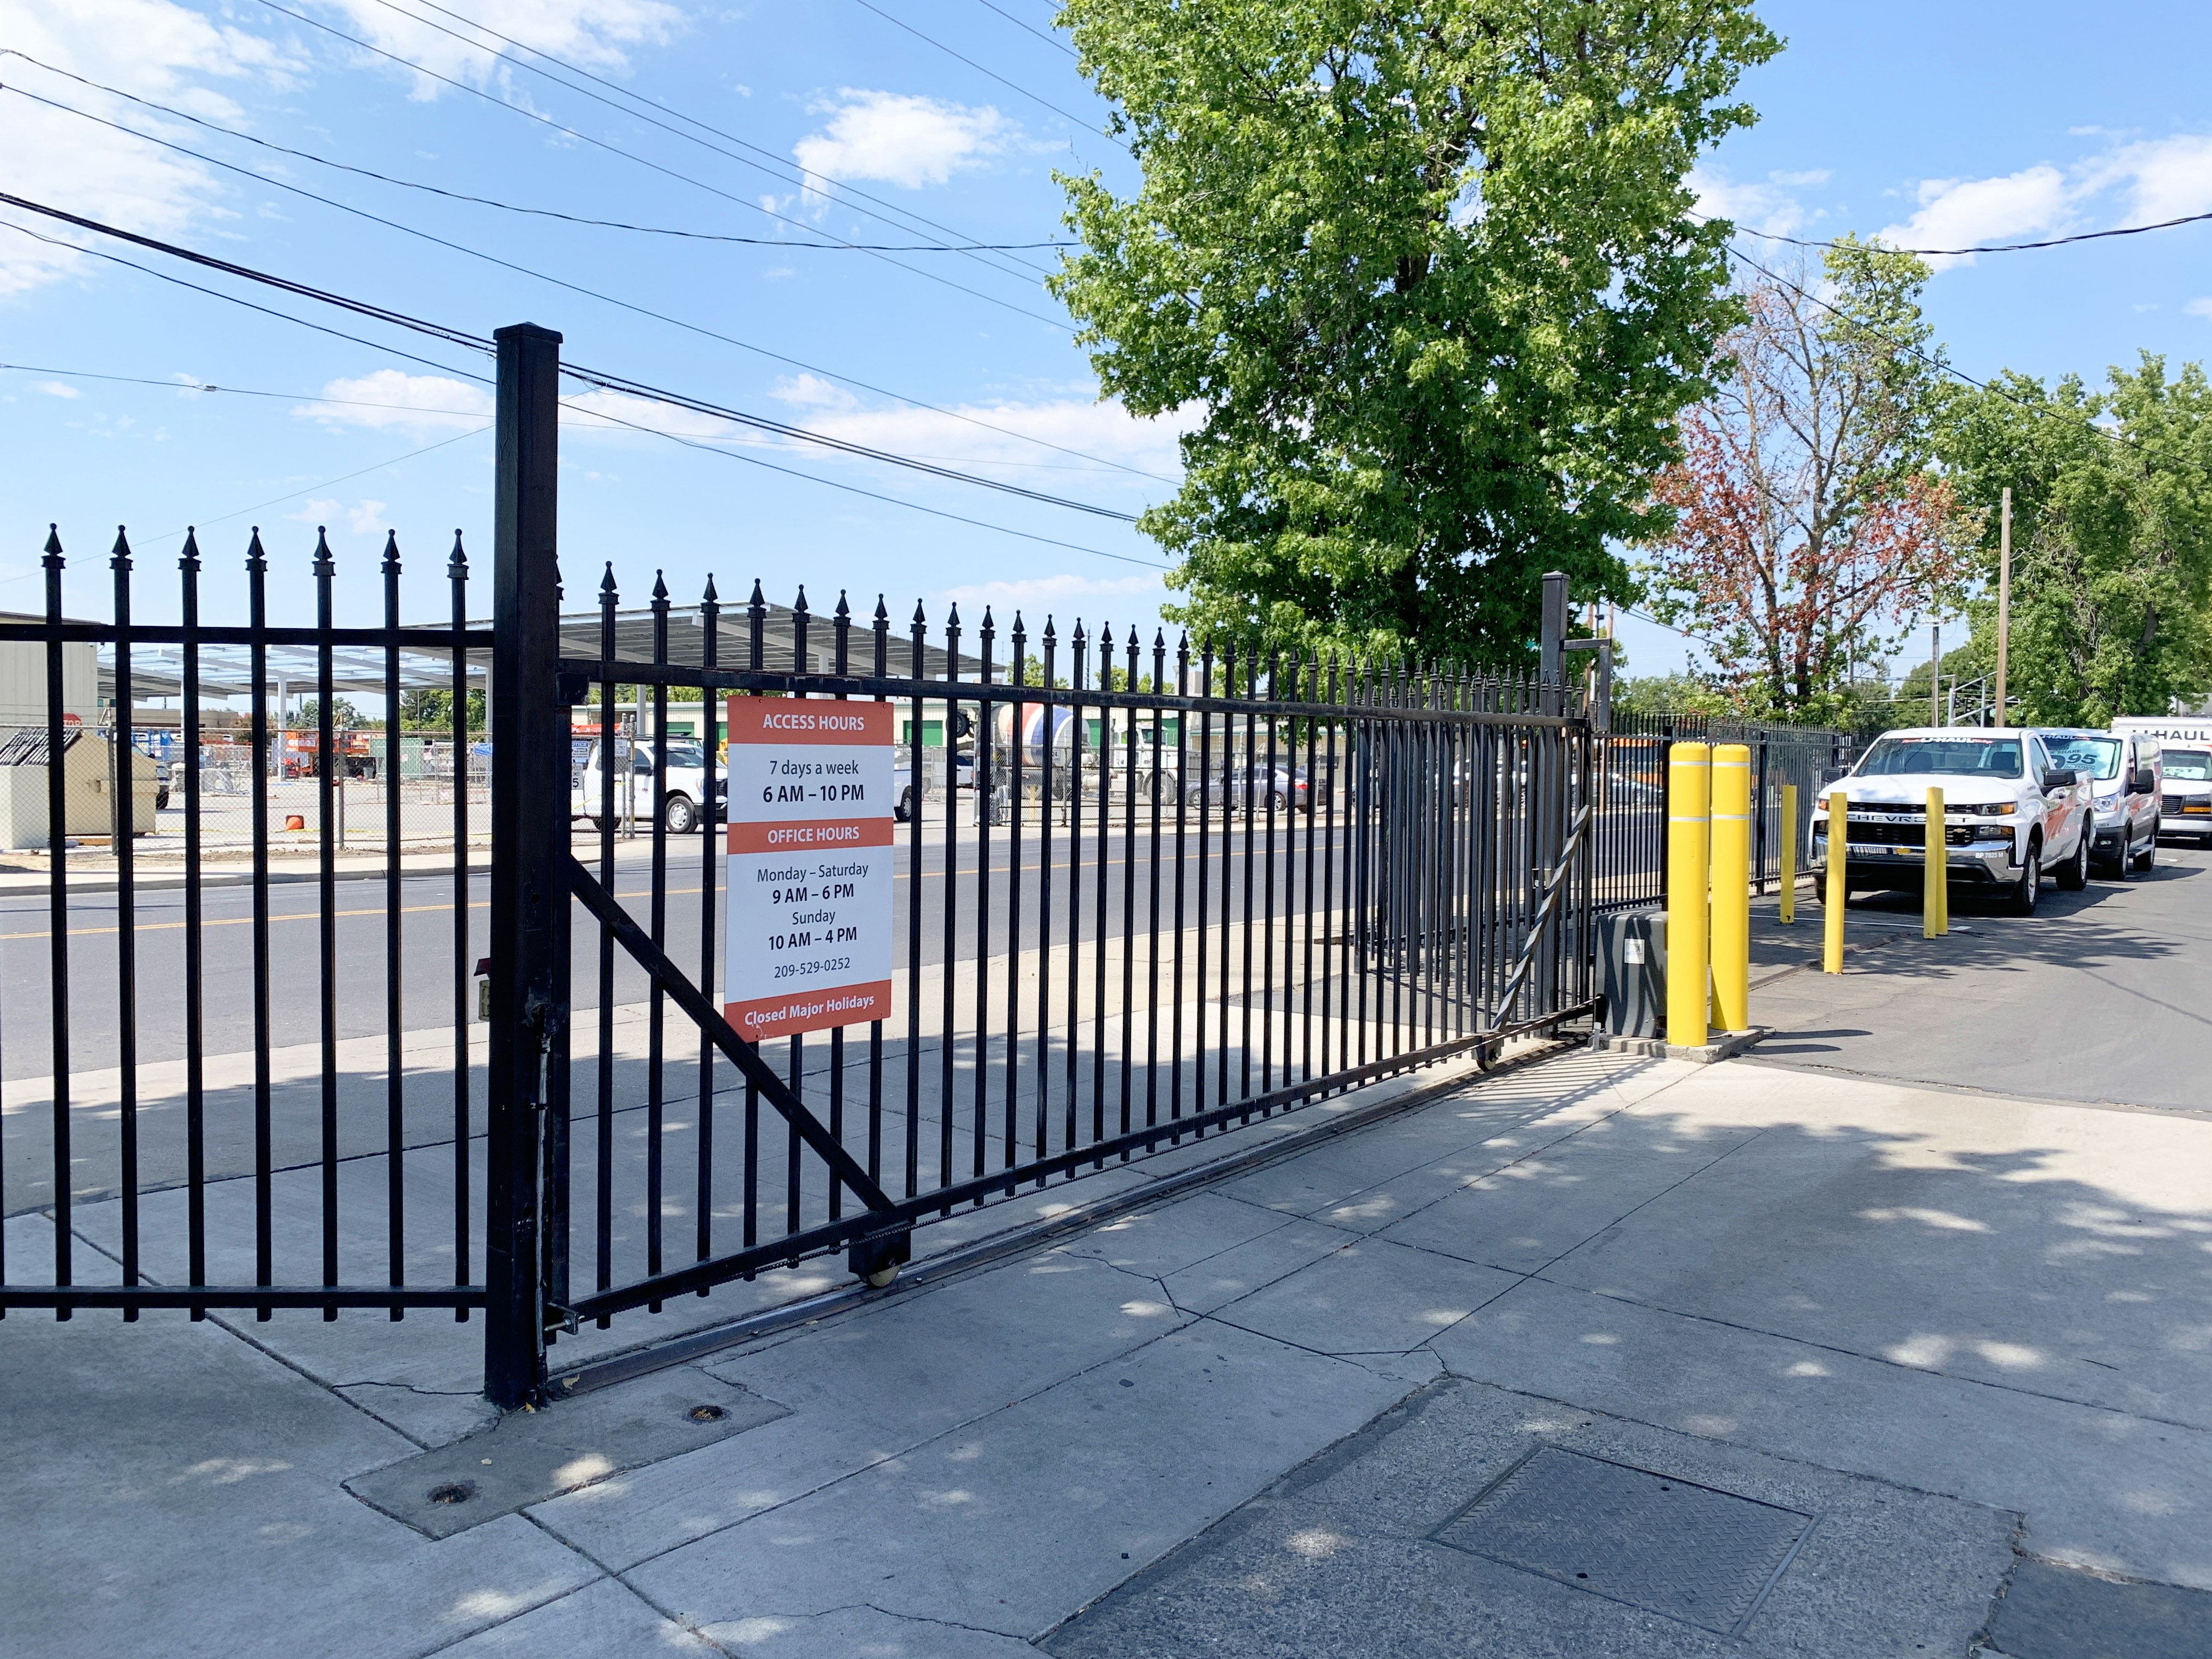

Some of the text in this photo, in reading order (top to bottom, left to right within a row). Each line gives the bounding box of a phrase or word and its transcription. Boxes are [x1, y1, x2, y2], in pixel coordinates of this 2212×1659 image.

[763, 714, 865, 731] ACCESS HOURS
[770, 759, 859, 779] 7 days a week
[763, 786, 773, 803] 6
[777, 785, 804, 802] AM
[820, 785, 837, 802] 10
[842, 785, 864, 801] PM
[1847, 814, 1971, 823] CHEVROET
[768, 826, 860, 844] OFFICE HOURS
[757, 866, 807, 883] Monday
[819, 862, 868, 878] Saturday
[772, 890, 781, 904] 9
[785, 887, 808, 903] AM
[822, 885, 830, 900] 6
[834, 883, 854, 899] PM
[792, 909, 836, 925] Sunday
[769, 935, 784, 950] 10
[788, 932, 810, 948] AM
[825, 929, 833, 944] 4
[837, 927, 857, 943] PM
[774, 957, 850, 978] 209-529-0252
[744, 995, 874, 1026] Closed Major Holidays
